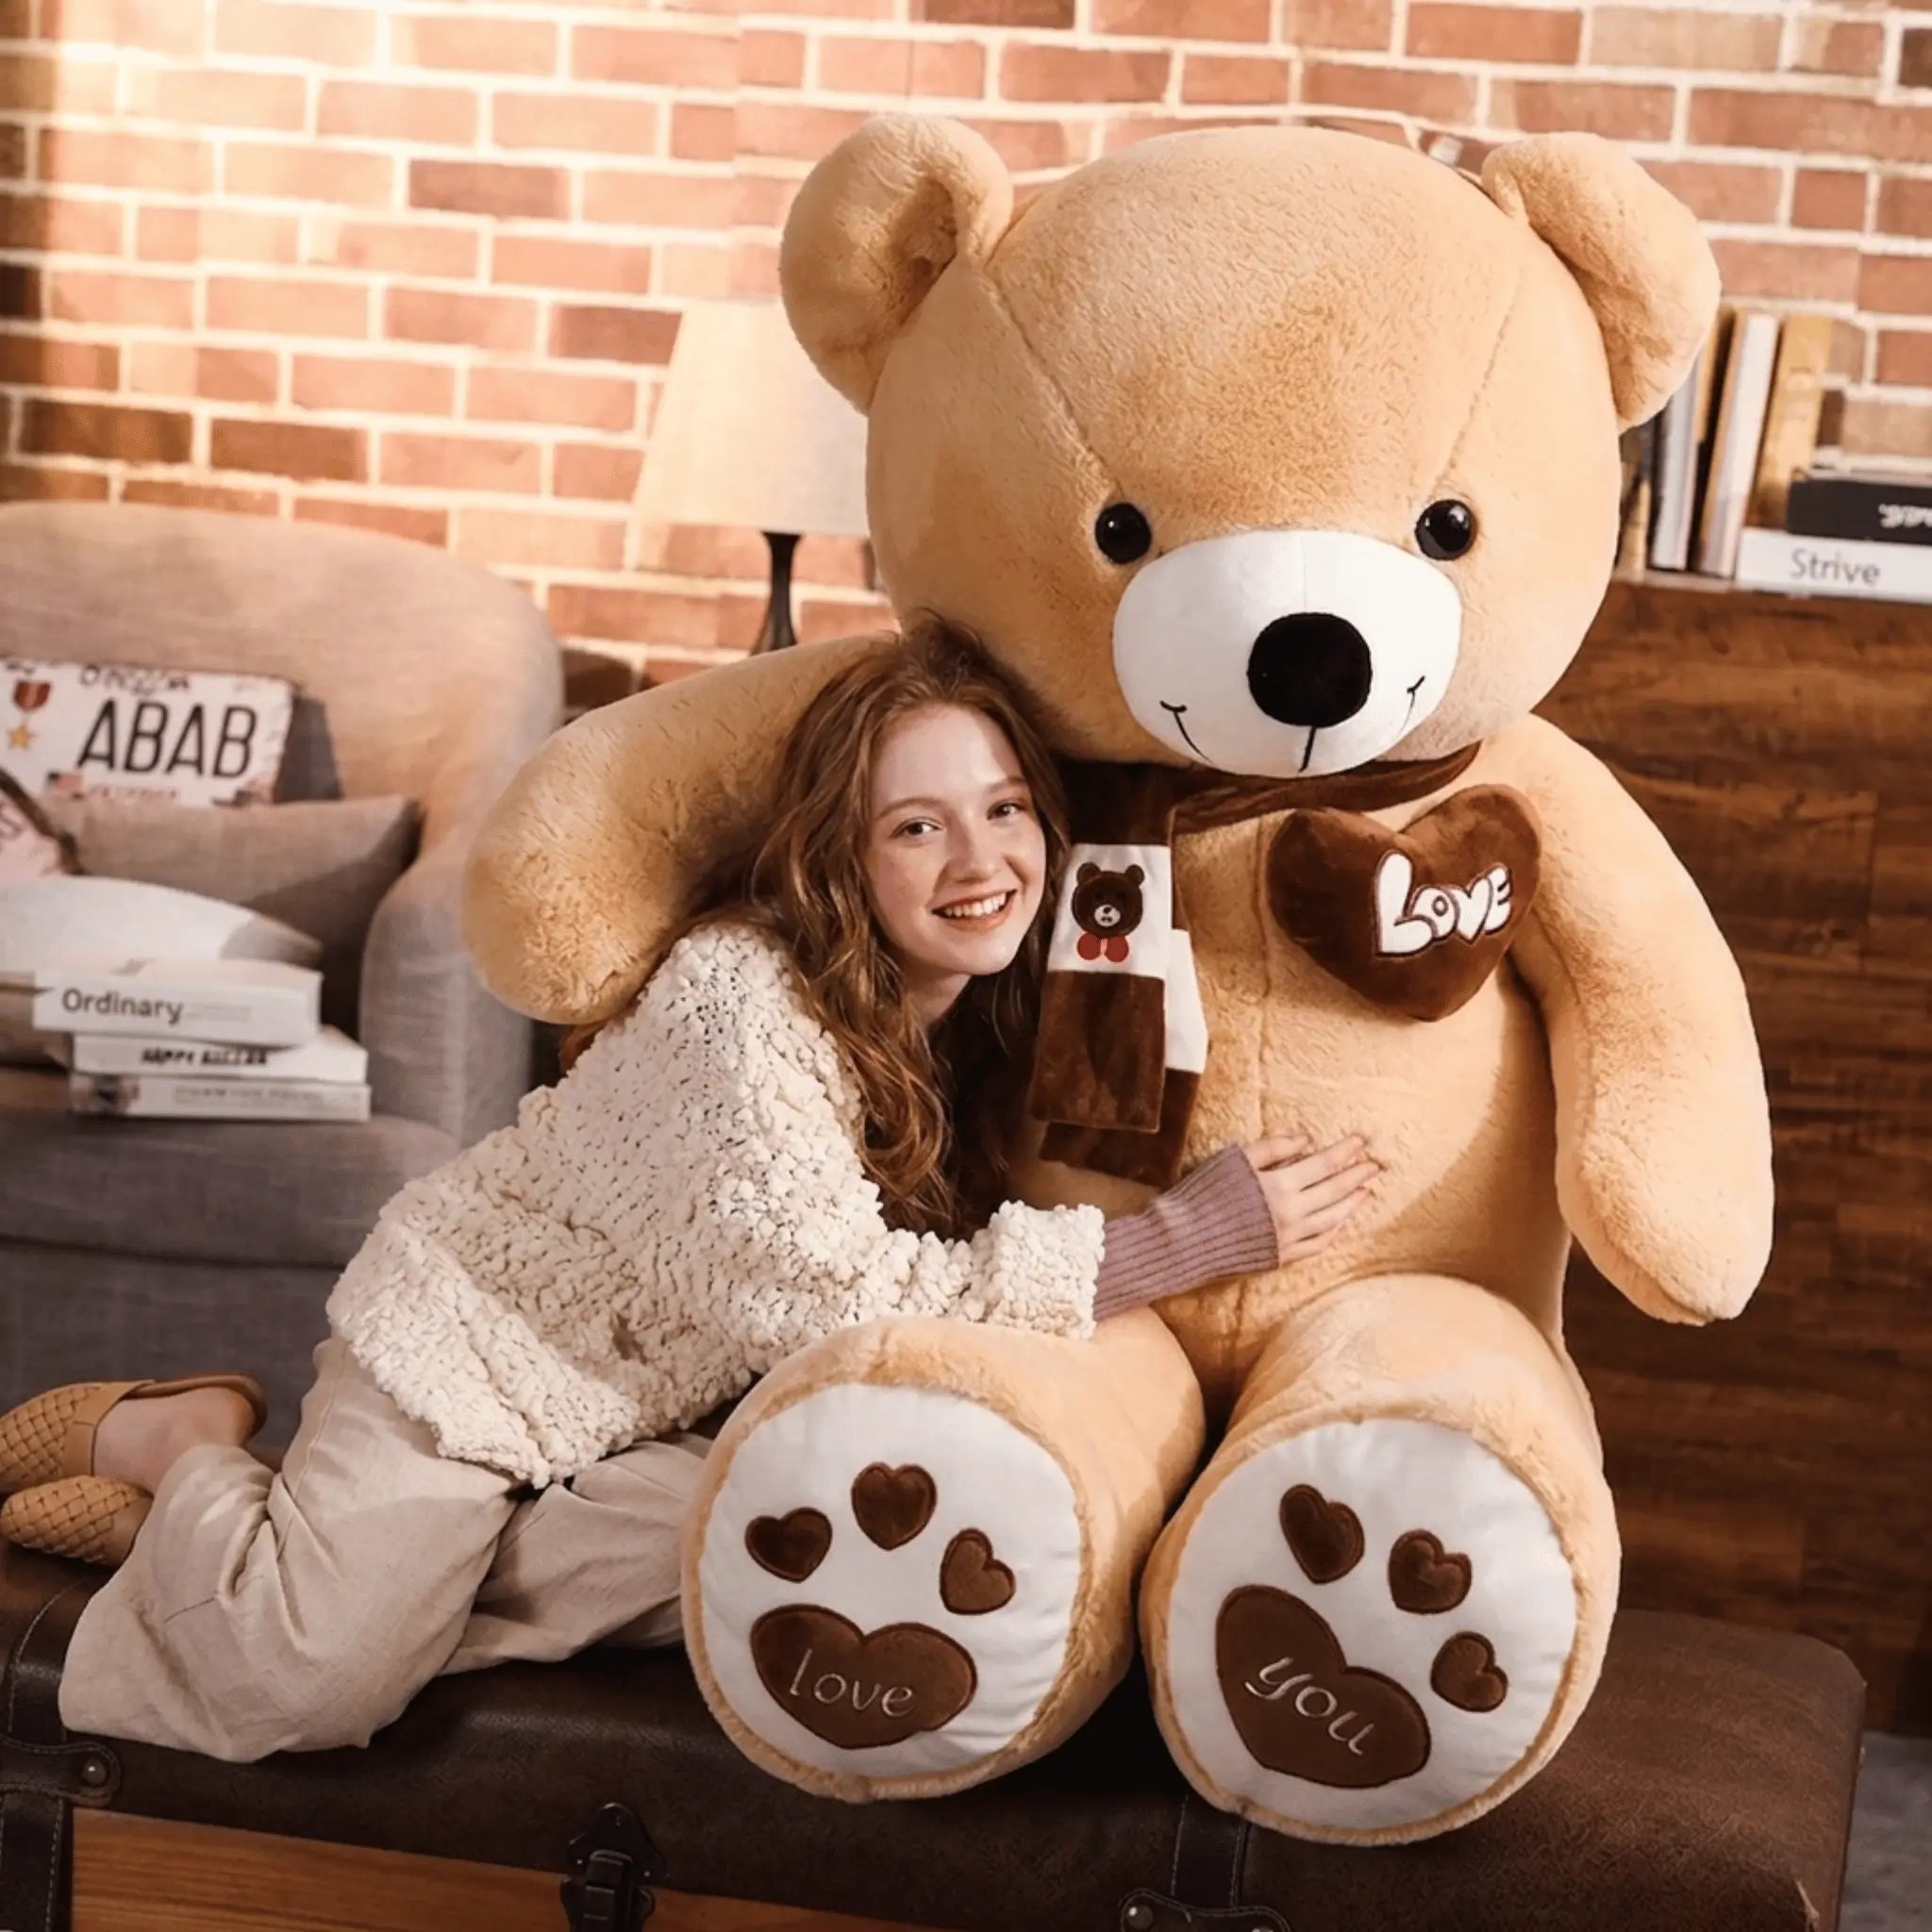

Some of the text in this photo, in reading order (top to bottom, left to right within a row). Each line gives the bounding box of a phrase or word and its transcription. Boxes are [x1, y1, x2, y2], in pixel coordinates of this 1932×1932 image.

[1790, 548, 1881, 586] Strive
[77, 697, 258, 778] ABAB
[61, 988, 185, 1026] Ordinary
[790, 1648, 913, 1718] love
[1243, 1657, 1374, 1757] you
